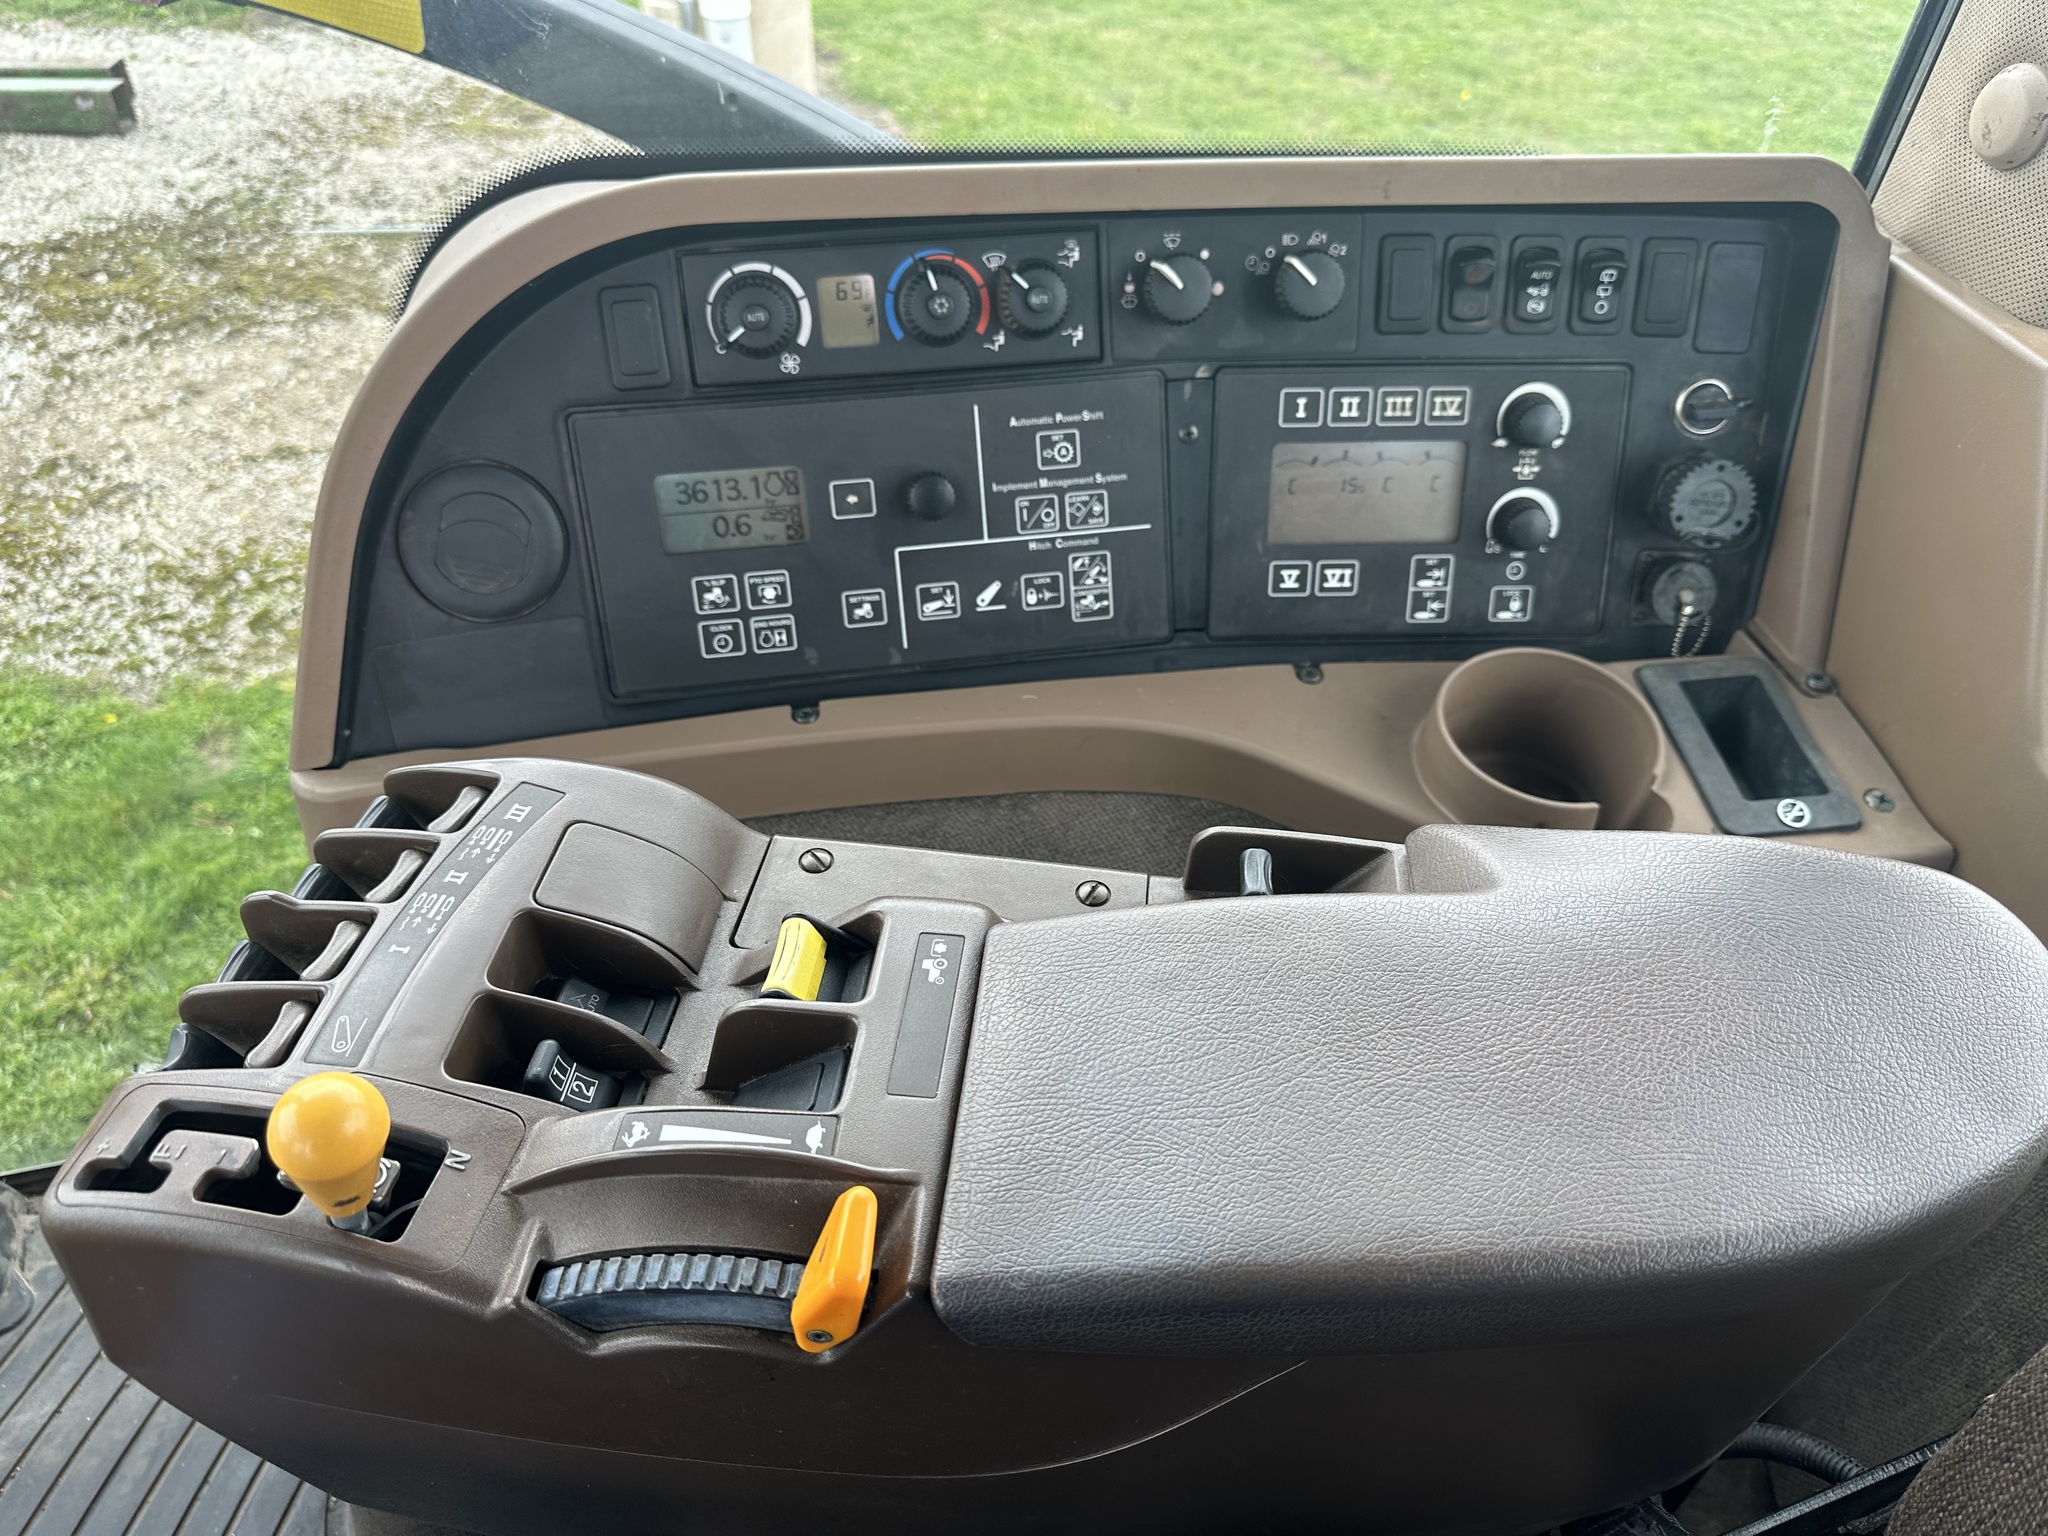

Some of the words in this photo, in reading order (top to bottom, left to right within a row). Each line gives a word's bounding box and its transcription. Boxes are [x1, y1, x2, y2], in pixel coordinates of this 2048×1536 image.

[1530, 269, 1553, 280] AUTO
[836, 281, 863, 301] 69
[747, 312, 765, 322] AUTO
[1295, 396, 1308, 418] I
[1340, 396, 1361, 418] II
[1384, 396, 1414, 418] III
[1431, 395, 1464, 417] IV
[1009, 415, 1054, 428] Automatic
[1055, 409, 1104, 424] PowerShift
[675, 476, 761, 506] 3613.1
[992, 481, 1038, 494] Implement
[1038, 477, 1095, 489] Management
[1095, 472, 1128, 484] System
[713, 514, 752, 539] 0.6
[1028, 540, 1052, 551] Hitch
[1055, 537, 1100, 549] Command
[1279, 569, 1301, 588] V
[1322, 568, 1353, 588] VI
[709, 624, 734, 633] CLOCK
[572, 1081, 594, 1097] 2
[444, 1149, 472, 1170] N
